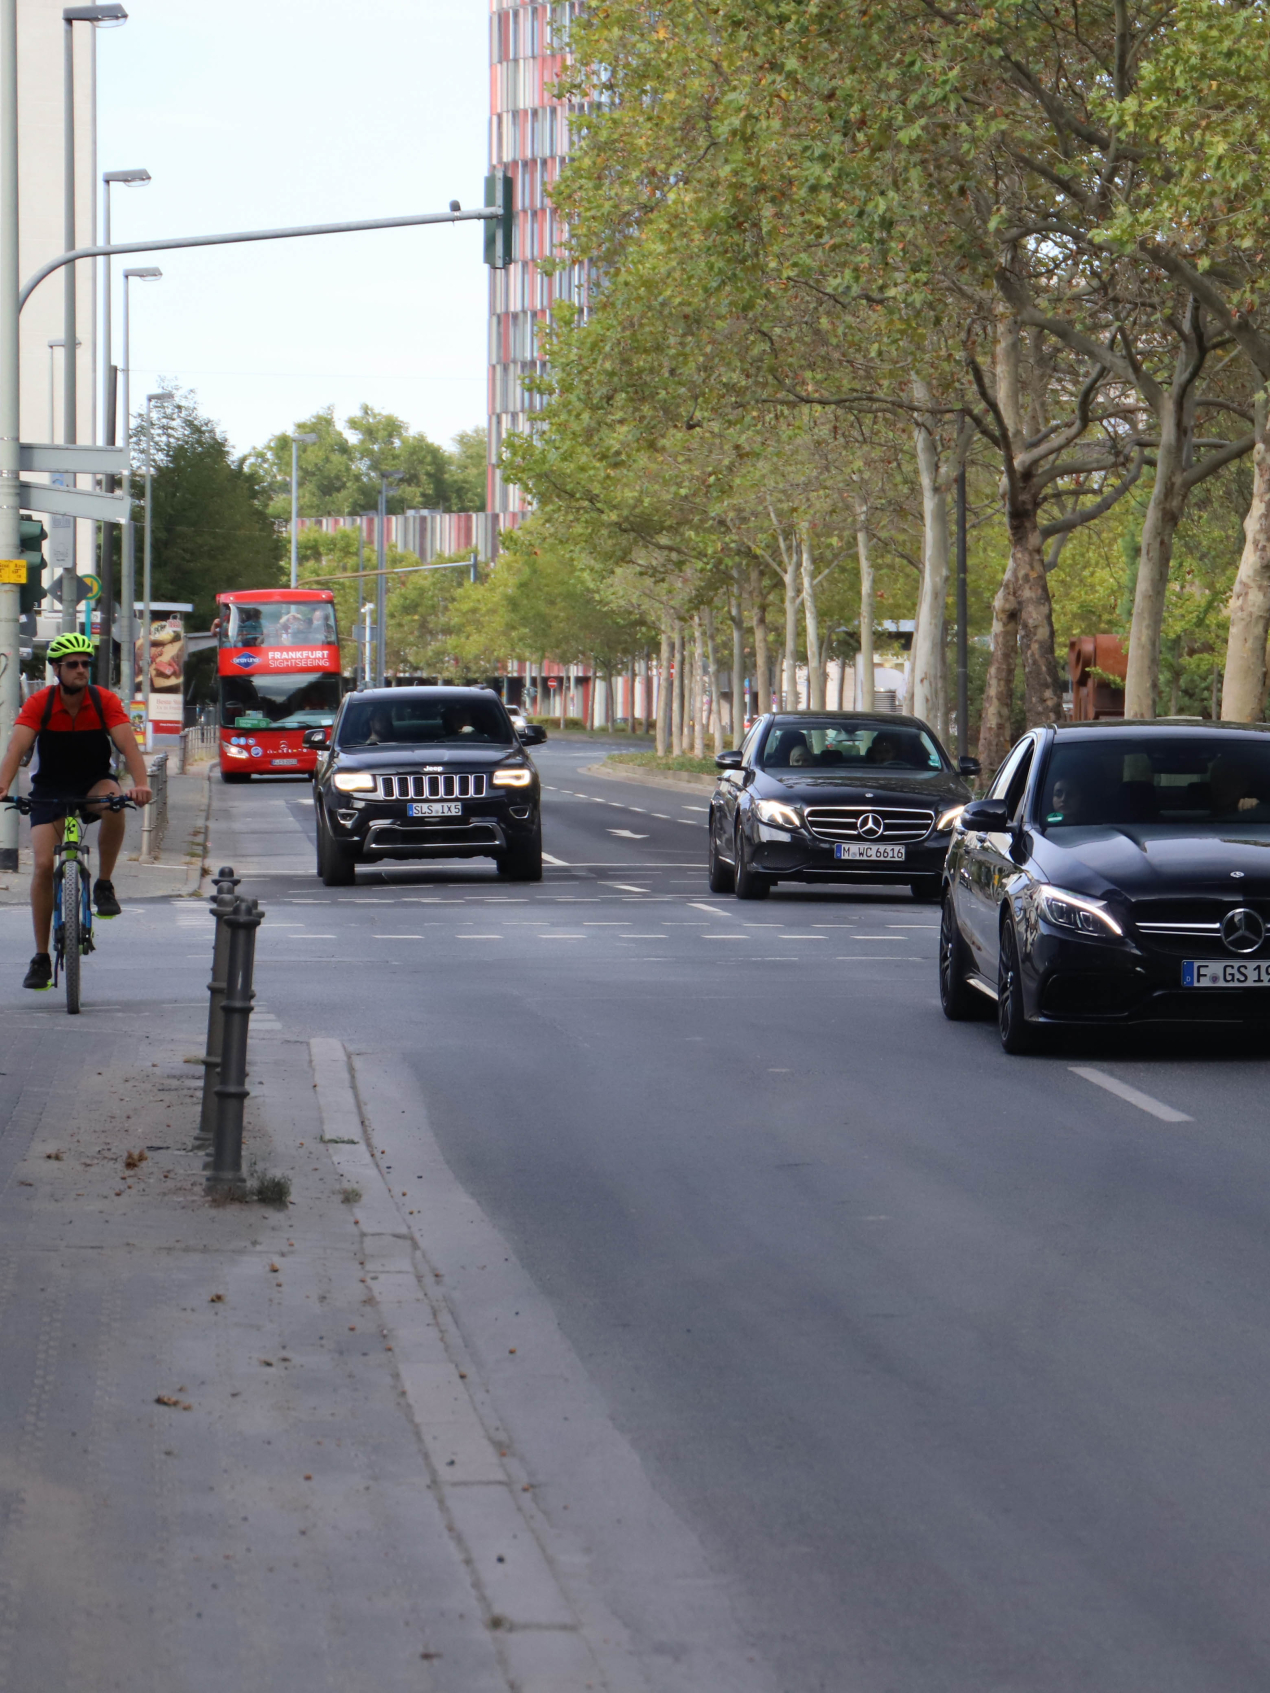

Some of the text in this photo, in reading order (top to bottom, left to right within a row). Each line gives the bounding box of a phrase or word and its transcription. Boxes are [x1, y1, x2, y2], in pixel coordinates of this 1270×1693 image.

[268, 651, 329, 659] FRANKFURT
[269, 659, 329, 667] SIGHTSEEING
[413, 805, 433, 815] SLS
[440, 804, 453, 814] IX
[842, 846, 903, 859] M WC 6616
[1196, 965, 1209, 983] F
[1223, 965, 1248, 983] GS
